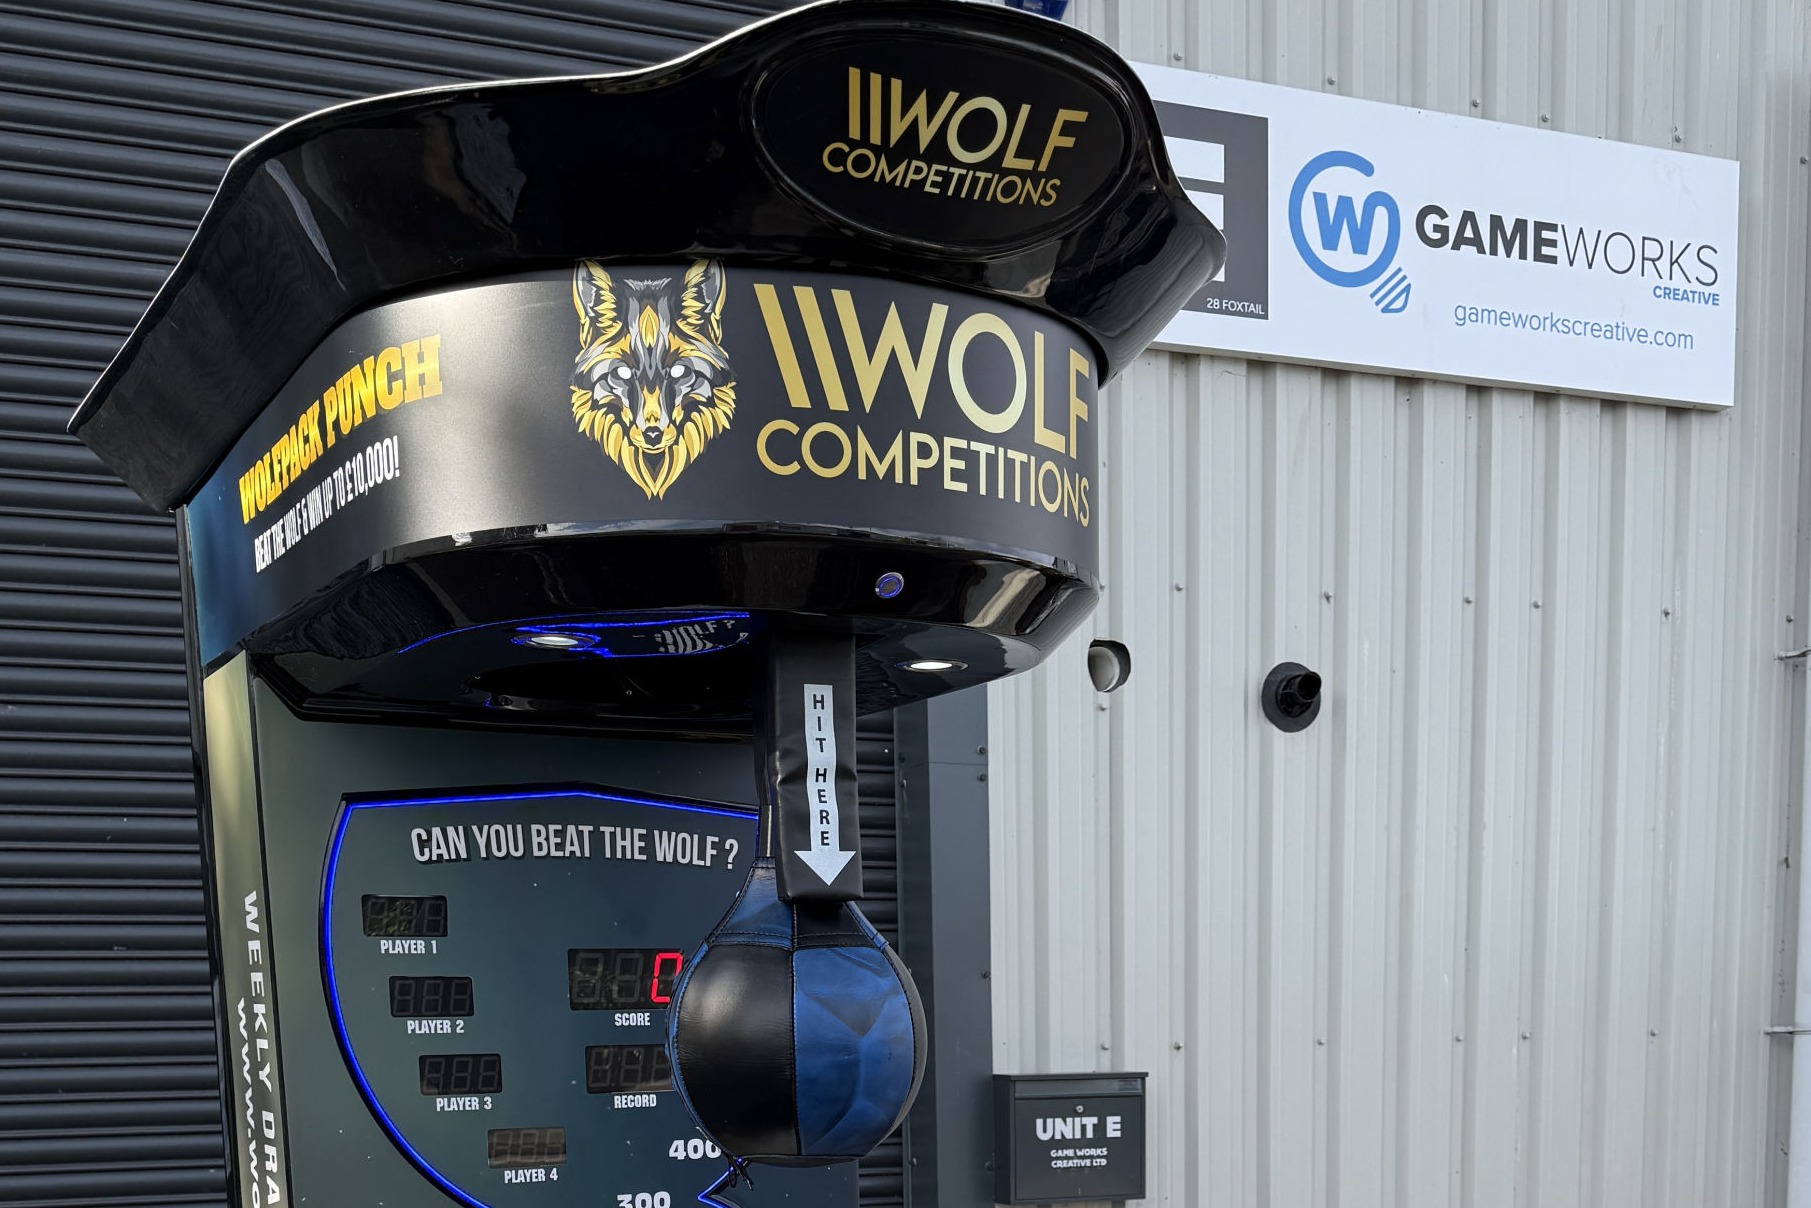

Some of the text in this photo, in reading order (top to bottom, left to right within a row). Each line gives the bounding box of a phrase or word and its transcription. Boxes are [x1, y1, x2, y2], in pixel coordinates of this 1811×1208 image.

[890, 78, 1088, 173] WOLF
[822, 142, 1061, 207] COMPETITIONS
[1415, 204, 1719, 287] GAMEWORKS
[1207, 298, 1265, 314] 28 FOXTAIL
[1652, 285, 1720, 306] CREATIVE
[1454, 304, 1694, 349] gameworkscreative.com
[832, 287, 1091, 460] WOLF
[238, 334, 442, 524] WOLFPACK PUNCH
[756, 419, 1090, 528] COMPETITIONS
[254, 435, 400, 573] BEAT THE WOLF & WIN UP TO £10,000!
[812, 694, 831, 846] HIT HERE
[410, 824, 739, 870] CAN YOU BEAT THE WOLF ?
[380, 939, 437, 954] PLAYER 1
[243, 890, 273, 1093] WEEKLY
[407, 1020, 464, 1034] PLAYER 2
[614, 1012, 650, 1026] SCORE
[436, 1097, 492, 1112] PLAYER 3
[614, 1095, 657, 1109] RECORD
[1036, 1116, 1121, 1141] UNIT E
[669, 1138, 721, 1160] 400
[1050, 1148, 1107, 1157] GAME WORKS
[504, 1167, 558, 1184] PLAYER 4
[1051, 1158, 1107, 1168] CREATIVE LTD
